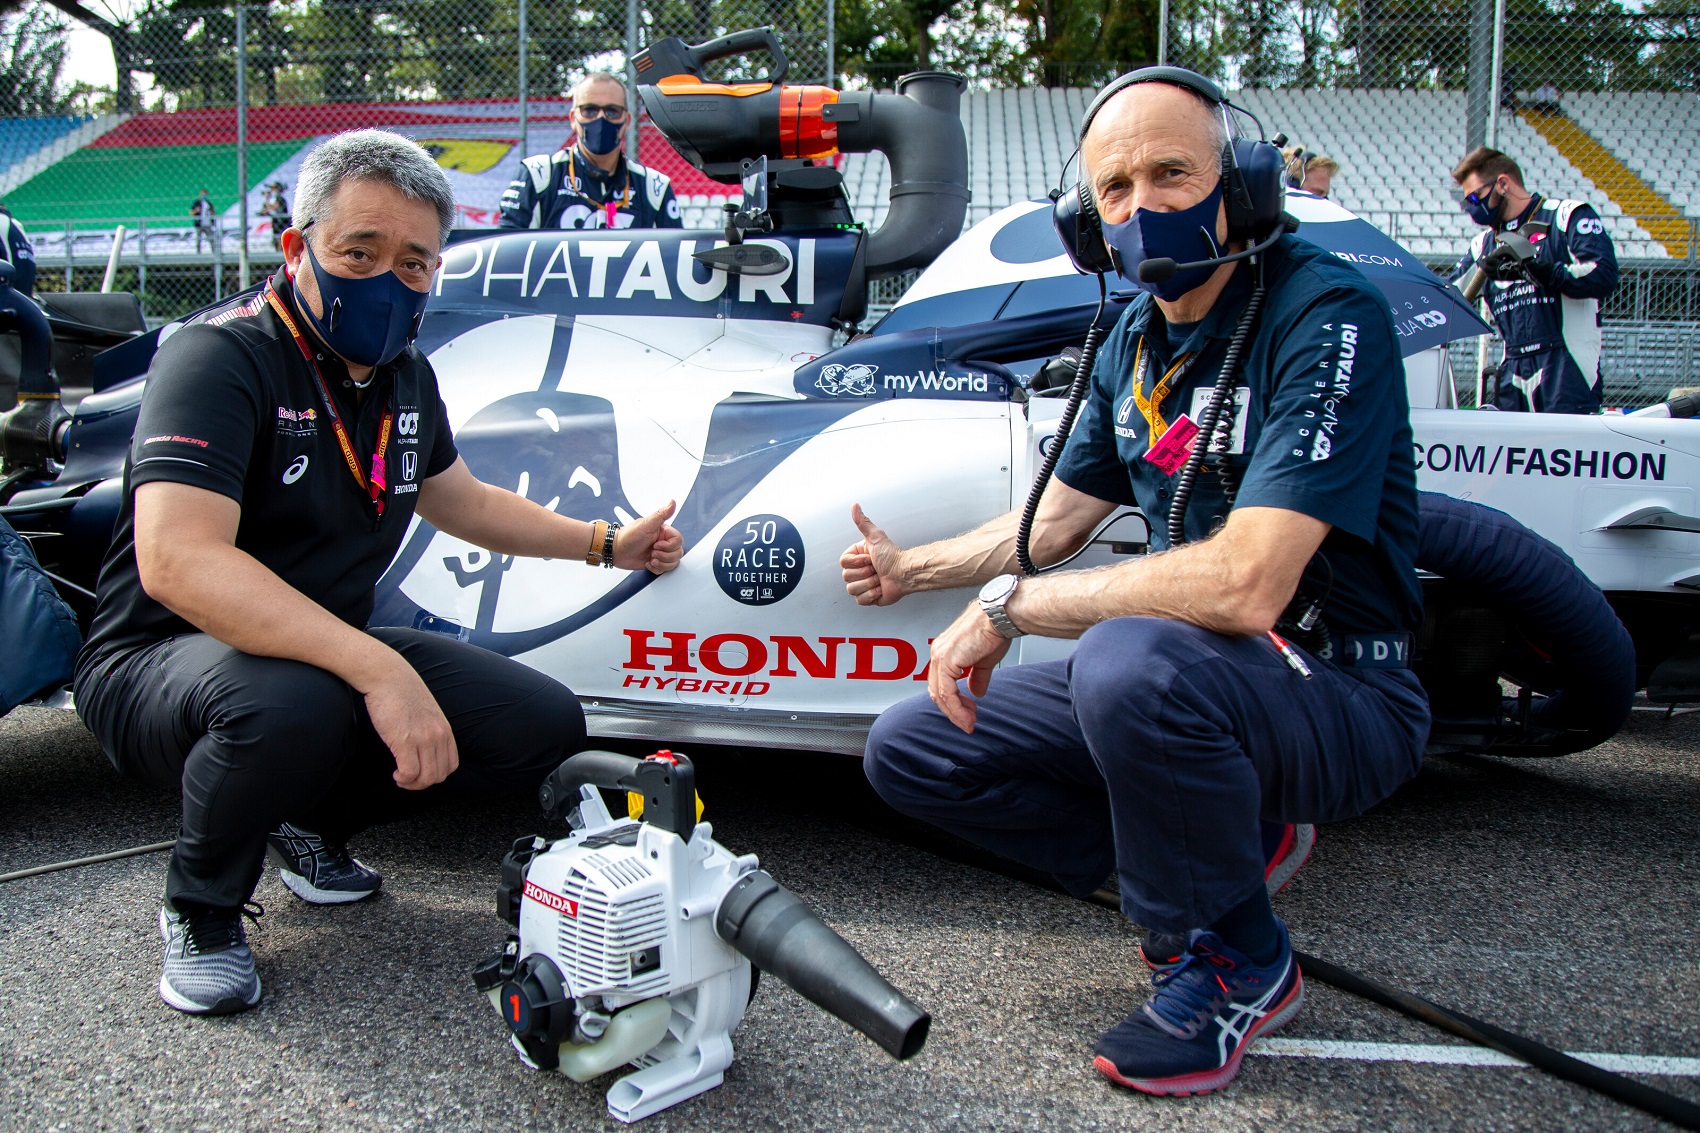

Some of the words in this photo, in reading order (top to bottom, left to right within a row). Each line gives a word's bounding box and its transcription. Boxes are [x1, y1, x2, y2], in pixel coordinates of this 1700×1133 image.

[1329, 251, 1403, 268] RI.COM
[435, 238, 816, 305] PHATAURI
[884, 370, 988, 393] myWorld
[171, 435, 209, 448] Racing
[1114, 424, 1137, 439] NDA
[395, 484, 417, 494] HONDA
[743, 520, 777, 545] 50
[721, 547, 796, 569] RACES
[728, 572, 788, 583] TOGETHER
[622, 628, 973, 683] HOND
[1319, 640, 1408, 661] BDY
[622, 674, 771, 696] HYBRID
[525, 882, 574, 915] HONDA
[509, 994, 520, 1023] 1
